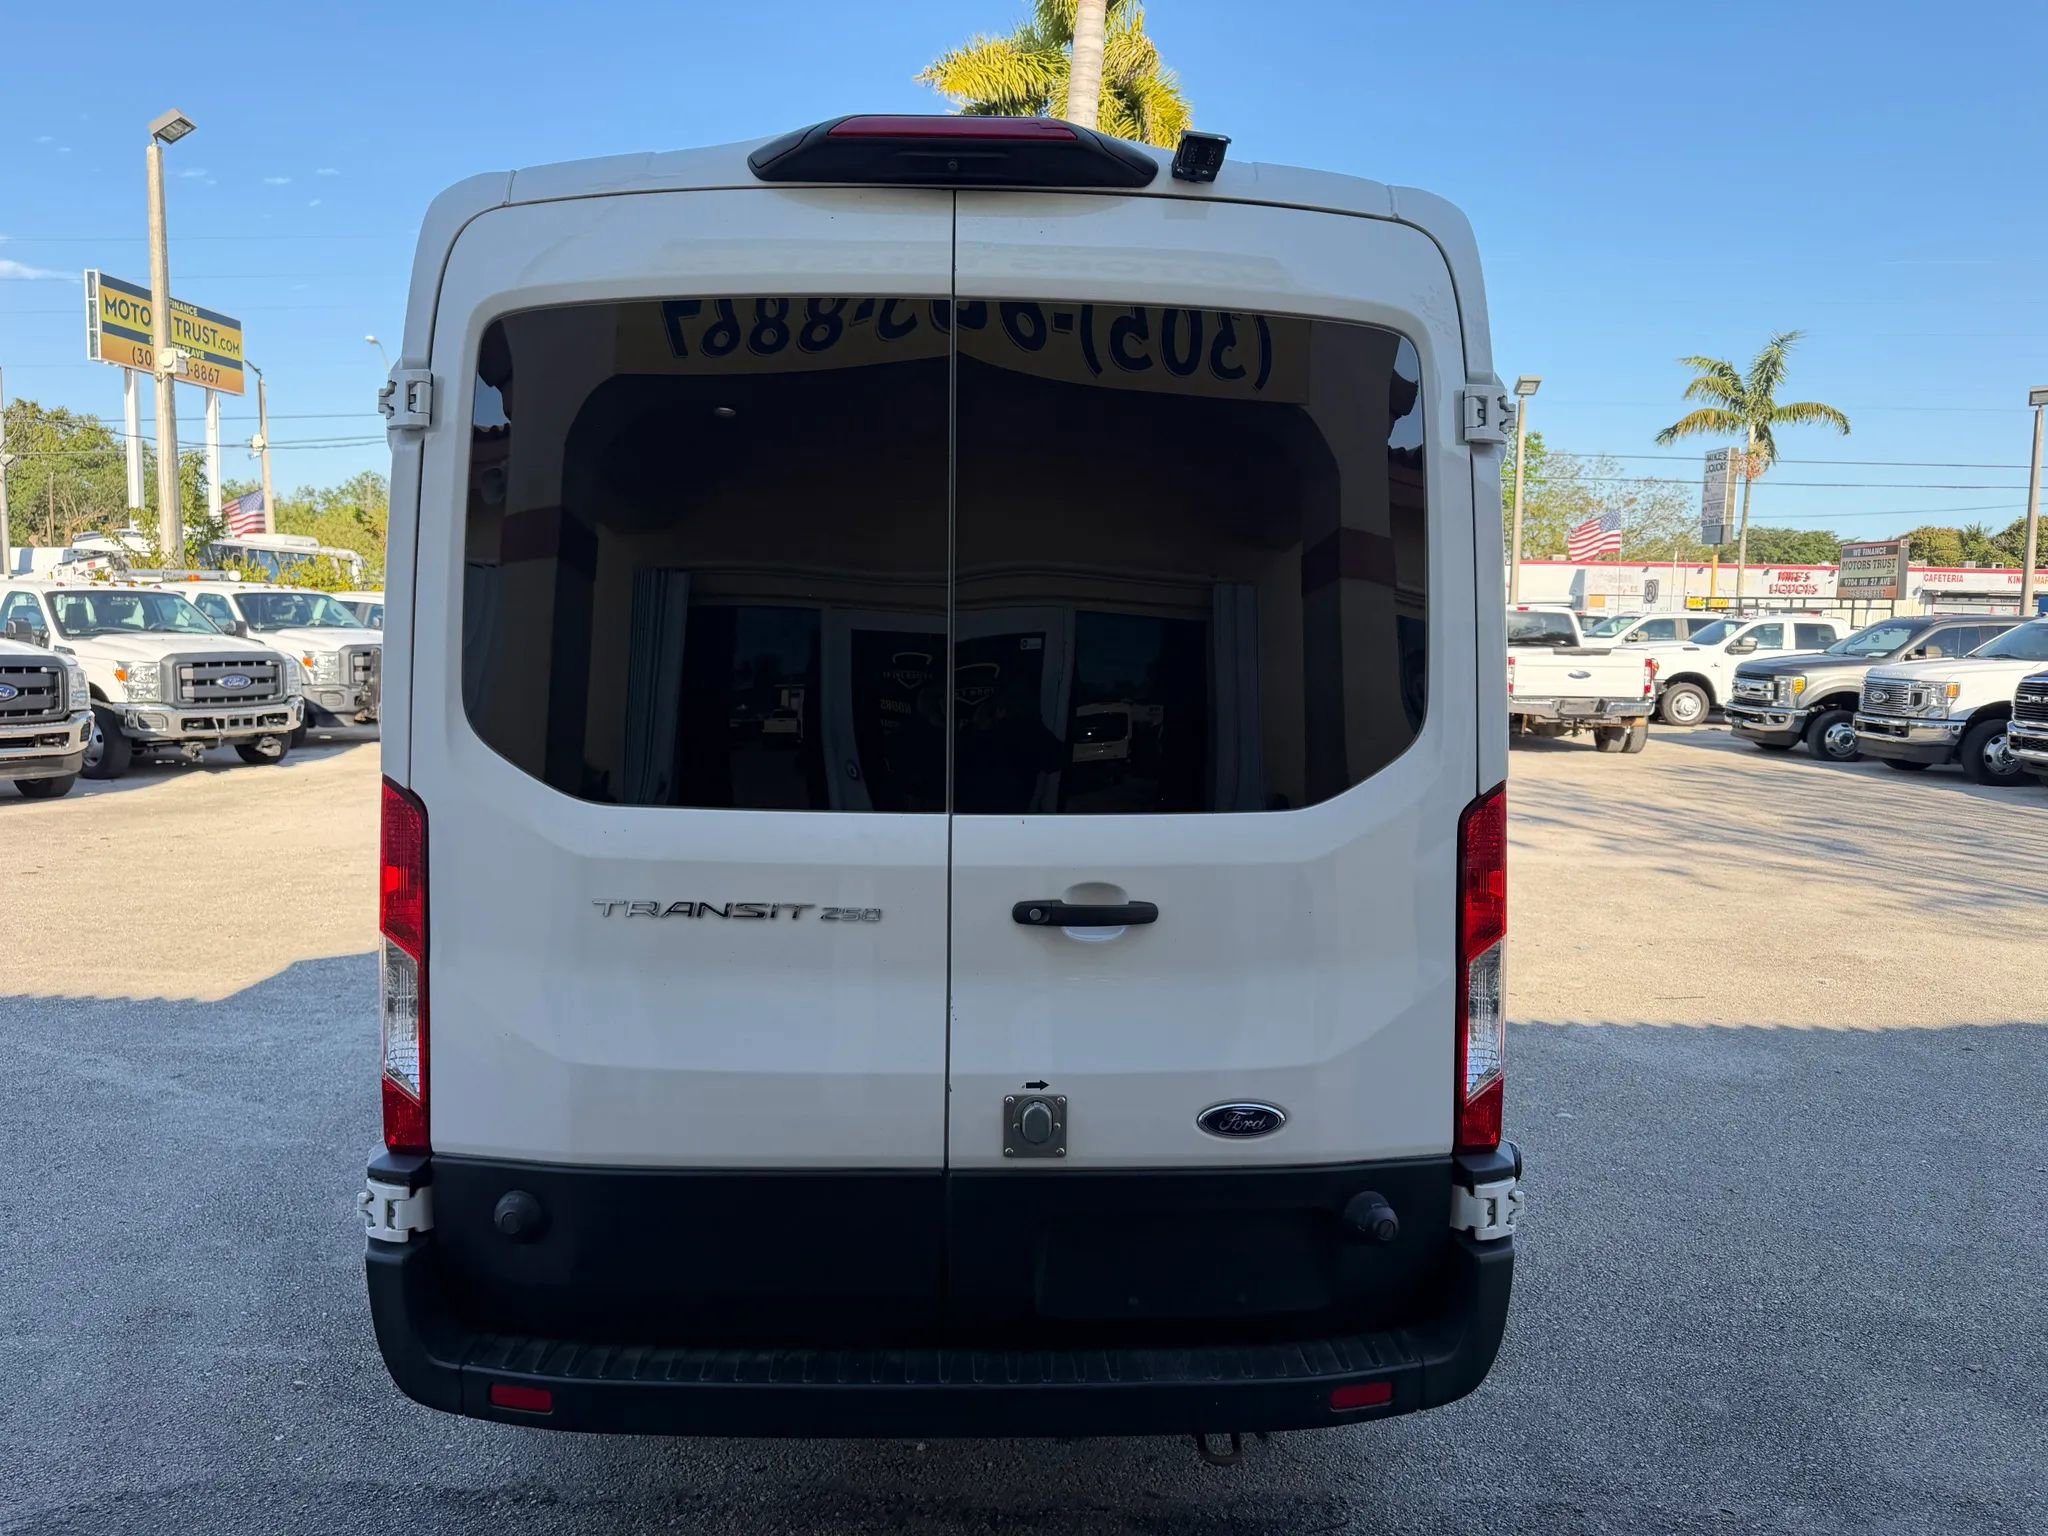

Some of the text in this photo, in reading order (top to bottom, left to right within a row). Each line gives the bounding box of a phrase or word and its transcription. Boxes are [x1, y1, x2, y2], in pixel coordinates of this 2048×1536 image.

[104, 294, 152, 328] MOTO
[1862, 546, 1887, 556] FINANCE
[1842, 558, 1896, 571] MOTORS TRUST
[1869, 578, 1877, 586] 27
[1879, 577, 1890, 585] AVE
[1924, 573, 1964, 583] CAFETERIA
[592, 899, 883, 922] TRANSIT 250
